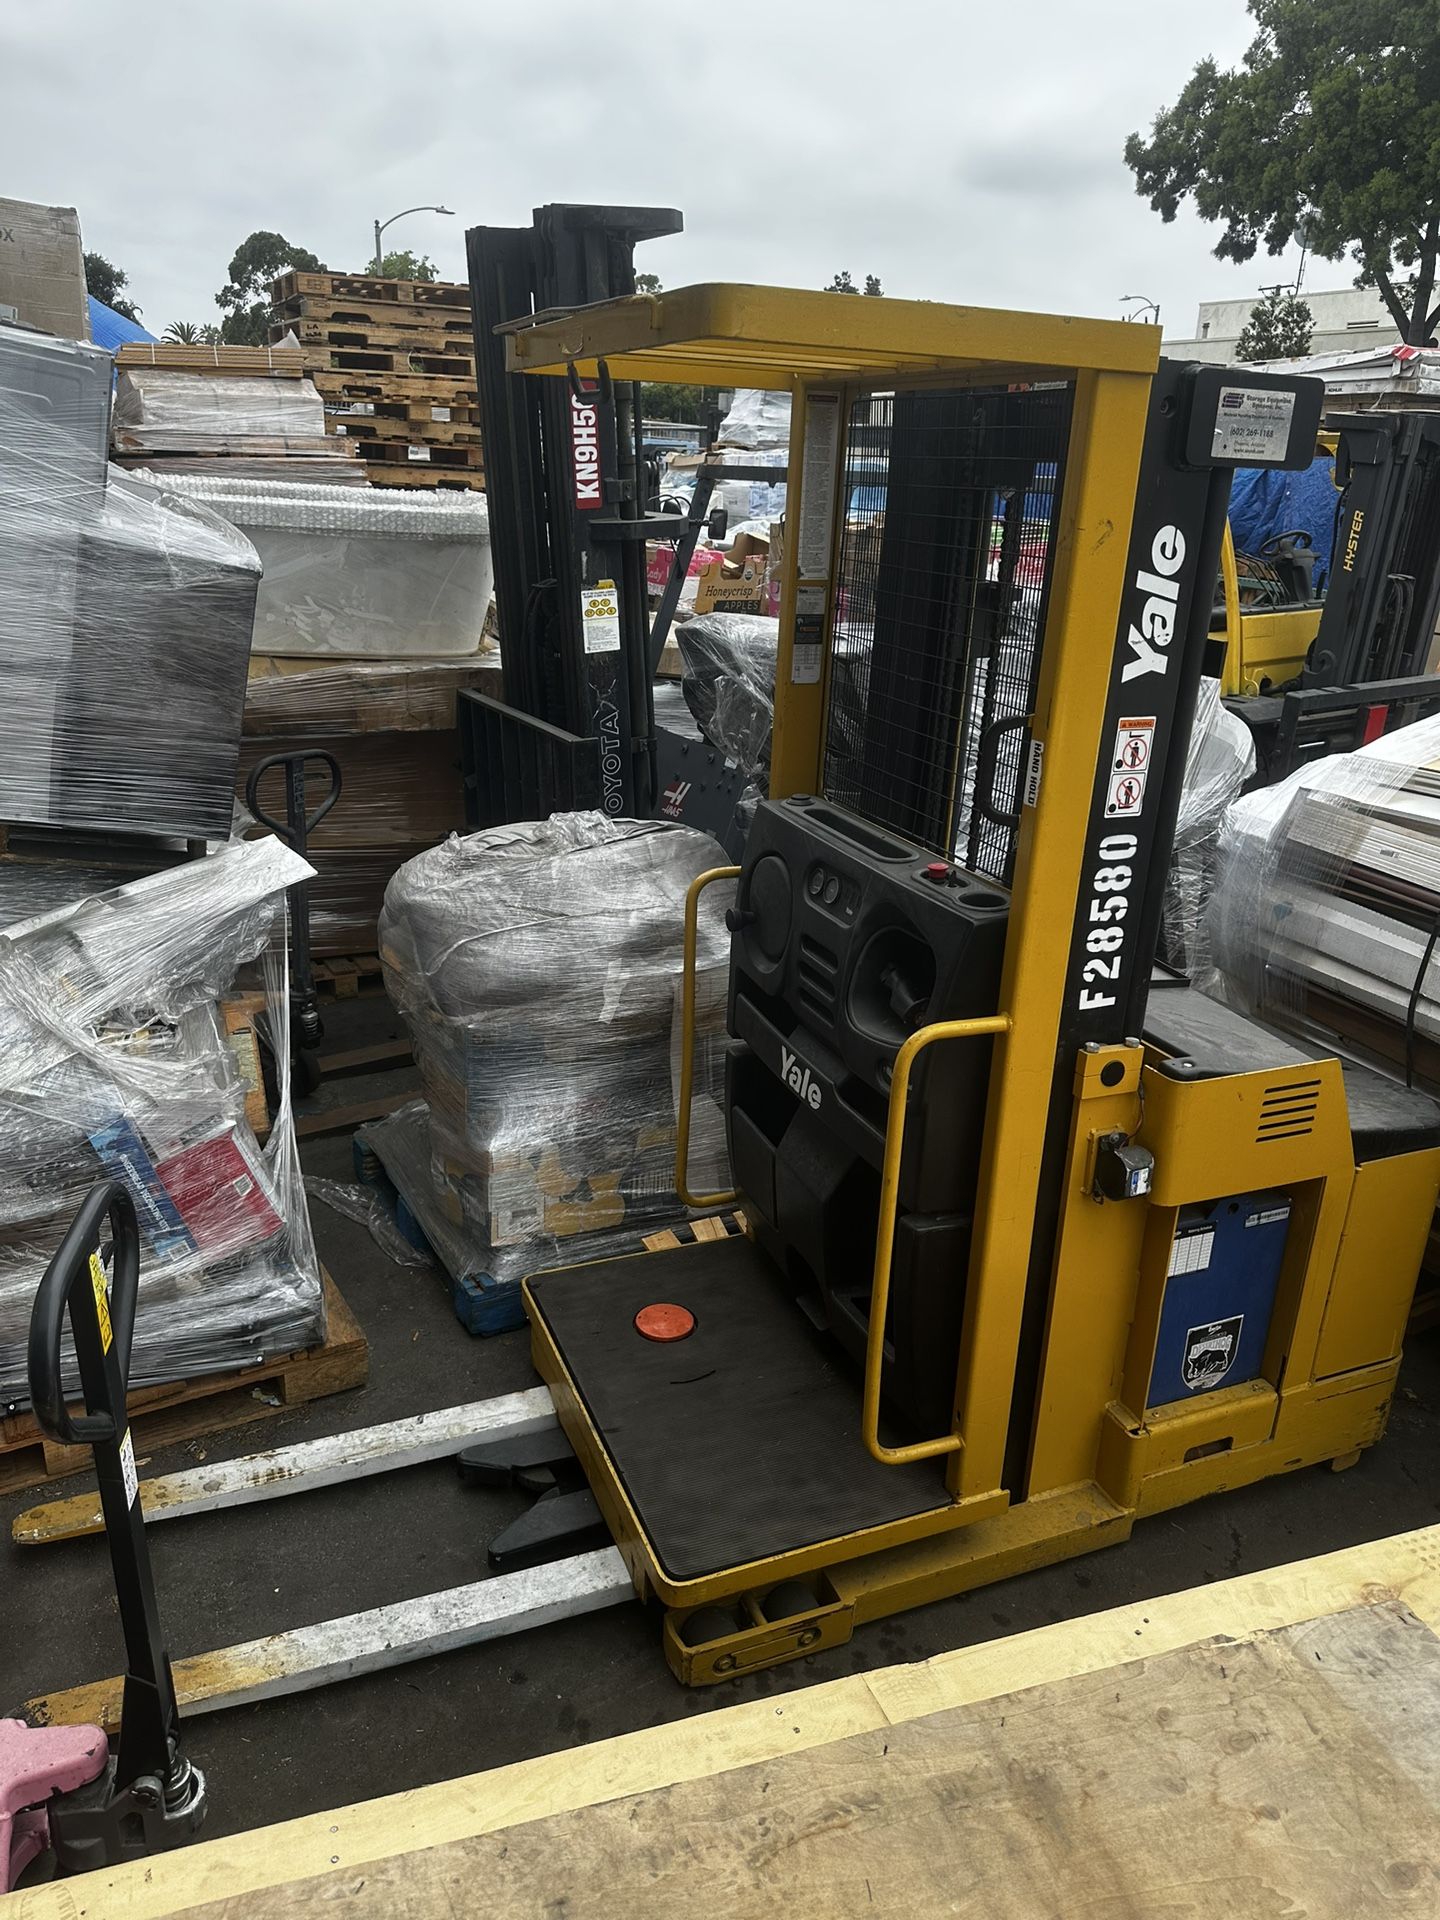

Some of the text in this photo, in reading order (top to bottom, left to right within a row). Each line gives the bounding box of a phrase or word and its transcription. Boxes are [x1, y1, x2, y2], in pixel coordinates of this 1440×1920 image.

[1343, 510, 1364, 572] HYSTER
[705, 585, 753, 599] Honeycrisp
[723, 600, 760, 610] APPLES
[1121, 524, 1186, 684] Yale
[1128, 720, 1152, 728] WARNING
[599, 707, 623, 814] OYOTA
[1027, 743, 1042, 805] HAND HOLD
[1079, 834, 1138, 1011] F28580
[781, 1044, 822, 1110] Yale
